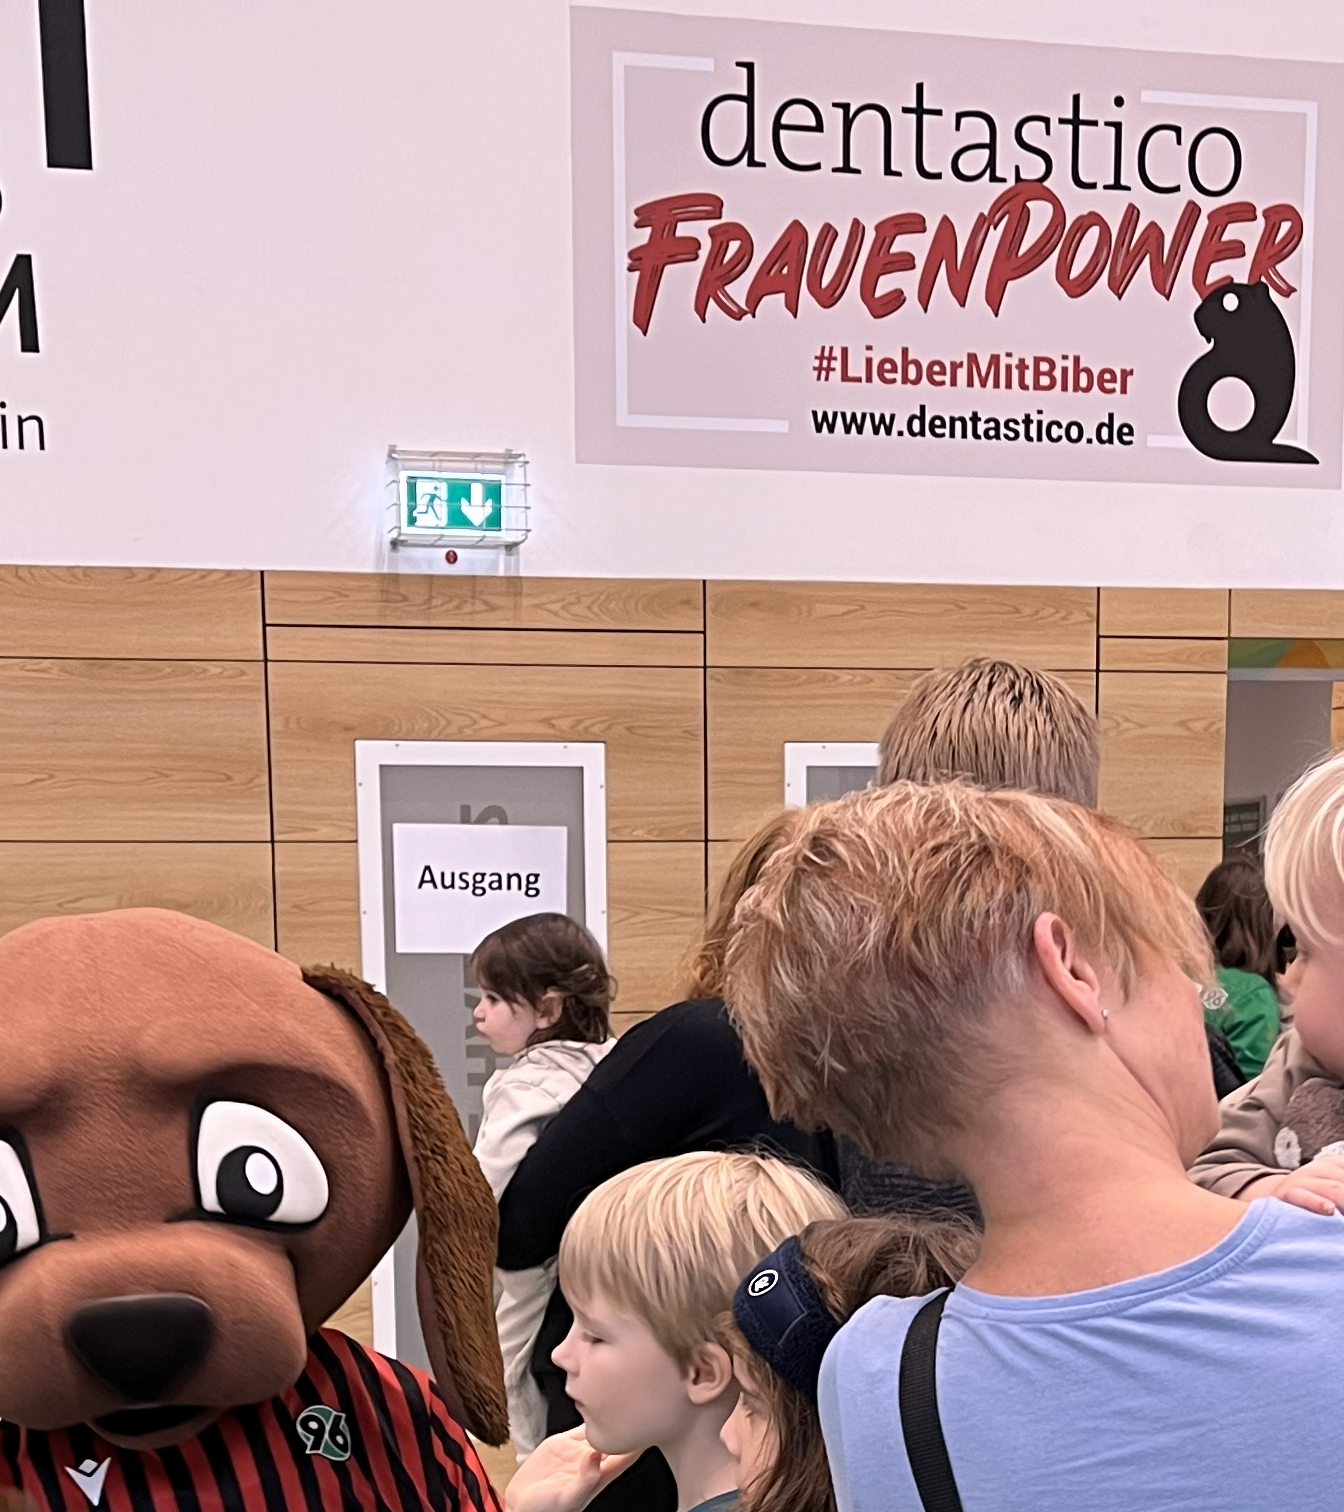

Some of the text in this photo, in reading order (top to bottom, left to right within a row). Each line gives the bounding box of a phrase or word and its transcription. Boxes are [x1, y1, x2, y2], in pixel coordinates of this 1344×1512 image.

[700, 60, 1243, 198] dentastico
[812, 344, 1135, 396] #LieberMitBiber
[811, 404, 1136, 448] www.dentastico.de
[416, 863, 542, 899] Ausgang
[297, 1404, 352, 1460] 96
